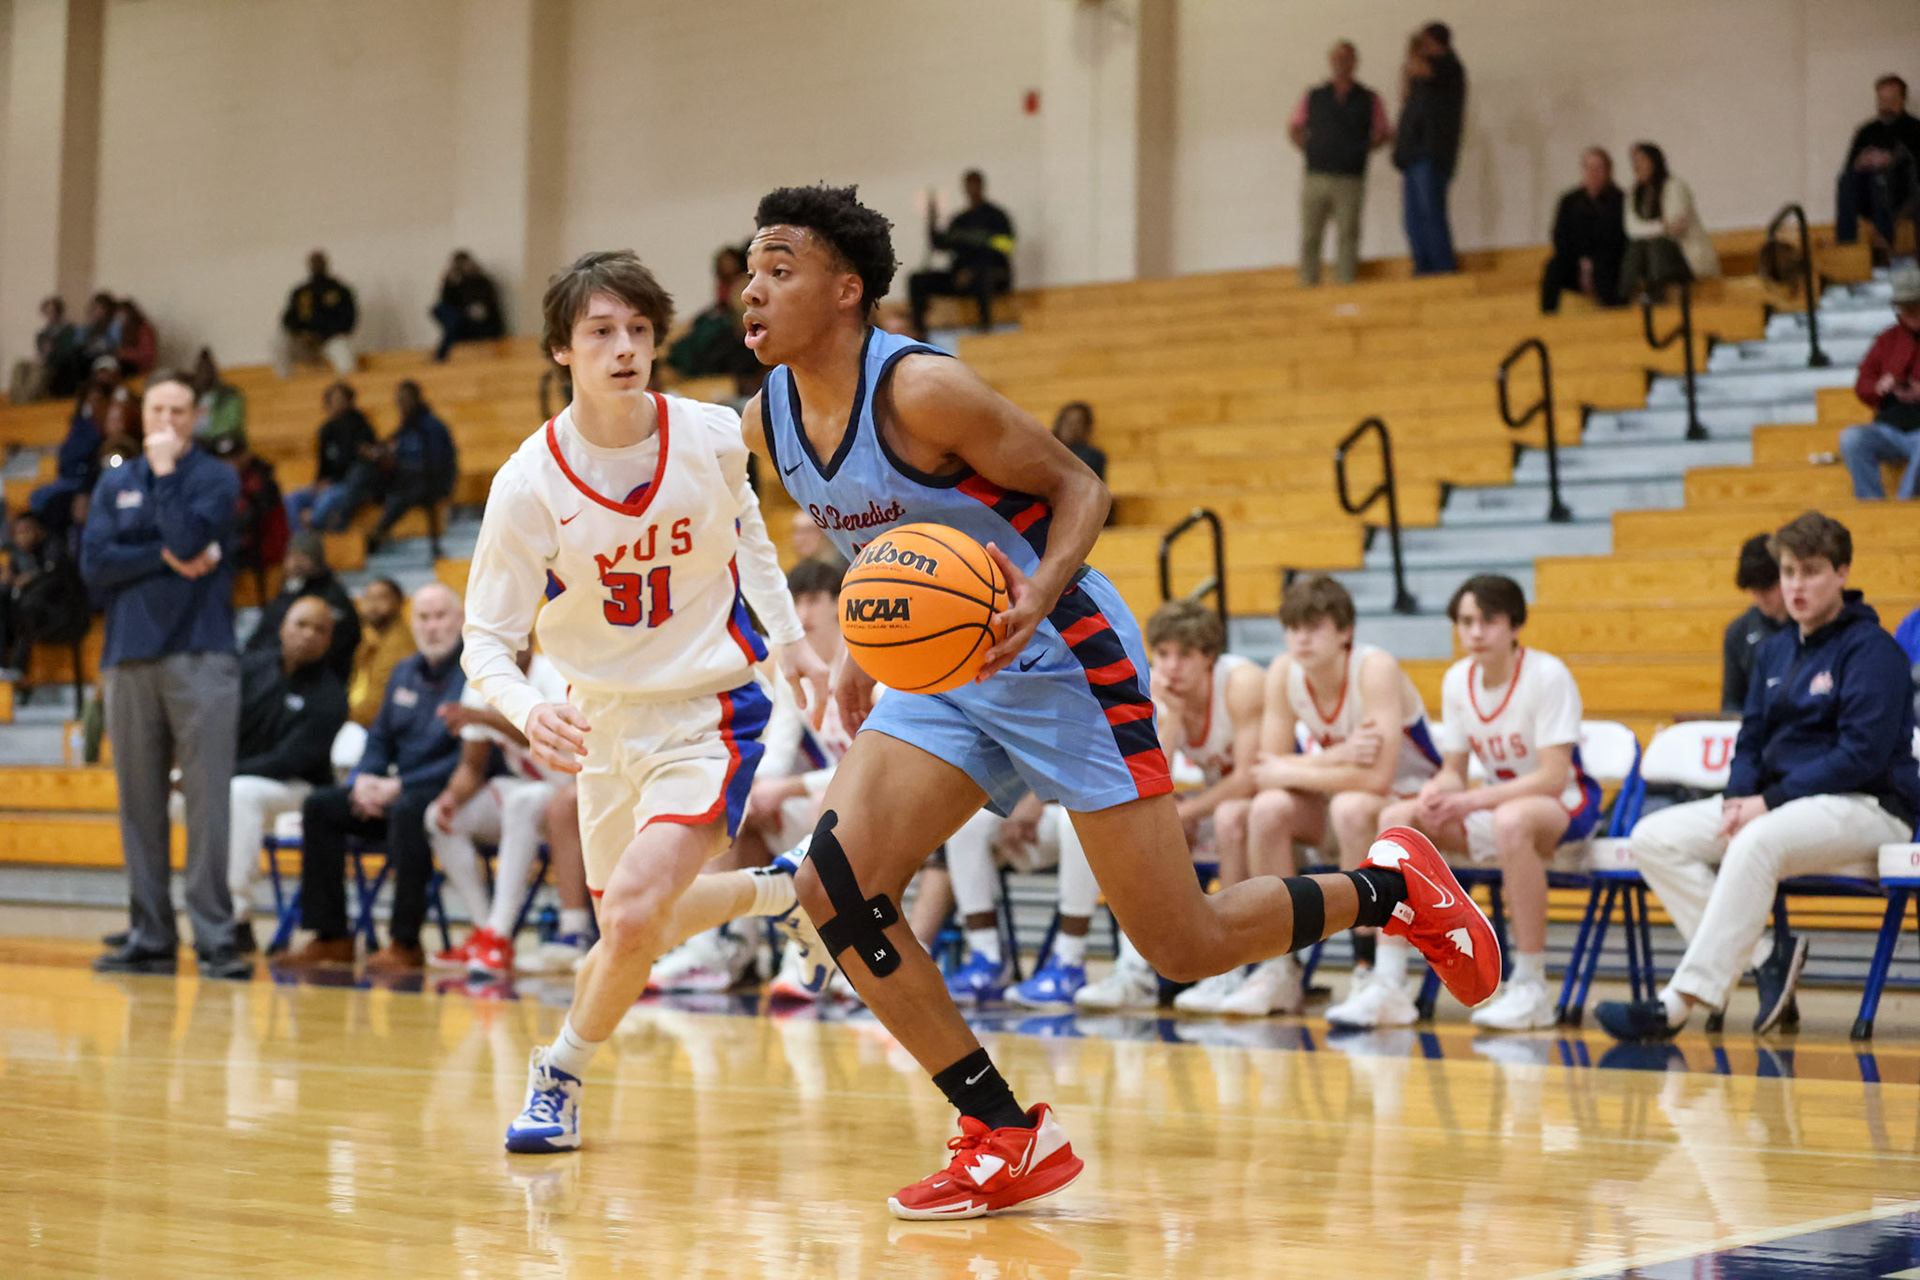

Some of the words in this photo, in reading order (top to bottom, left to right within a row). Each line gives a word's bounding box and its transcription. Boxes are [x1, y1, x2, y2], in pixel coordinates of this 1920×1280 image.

[825, 500, 906, 531] Benedict
[593, 517, 692, 581] MUS
[847, 541, 938, 577] Wilson
[602, 565, 673, 628] 31
[846, 597, 910, 622] NCAA
[874, 948, 887, 962] KT
